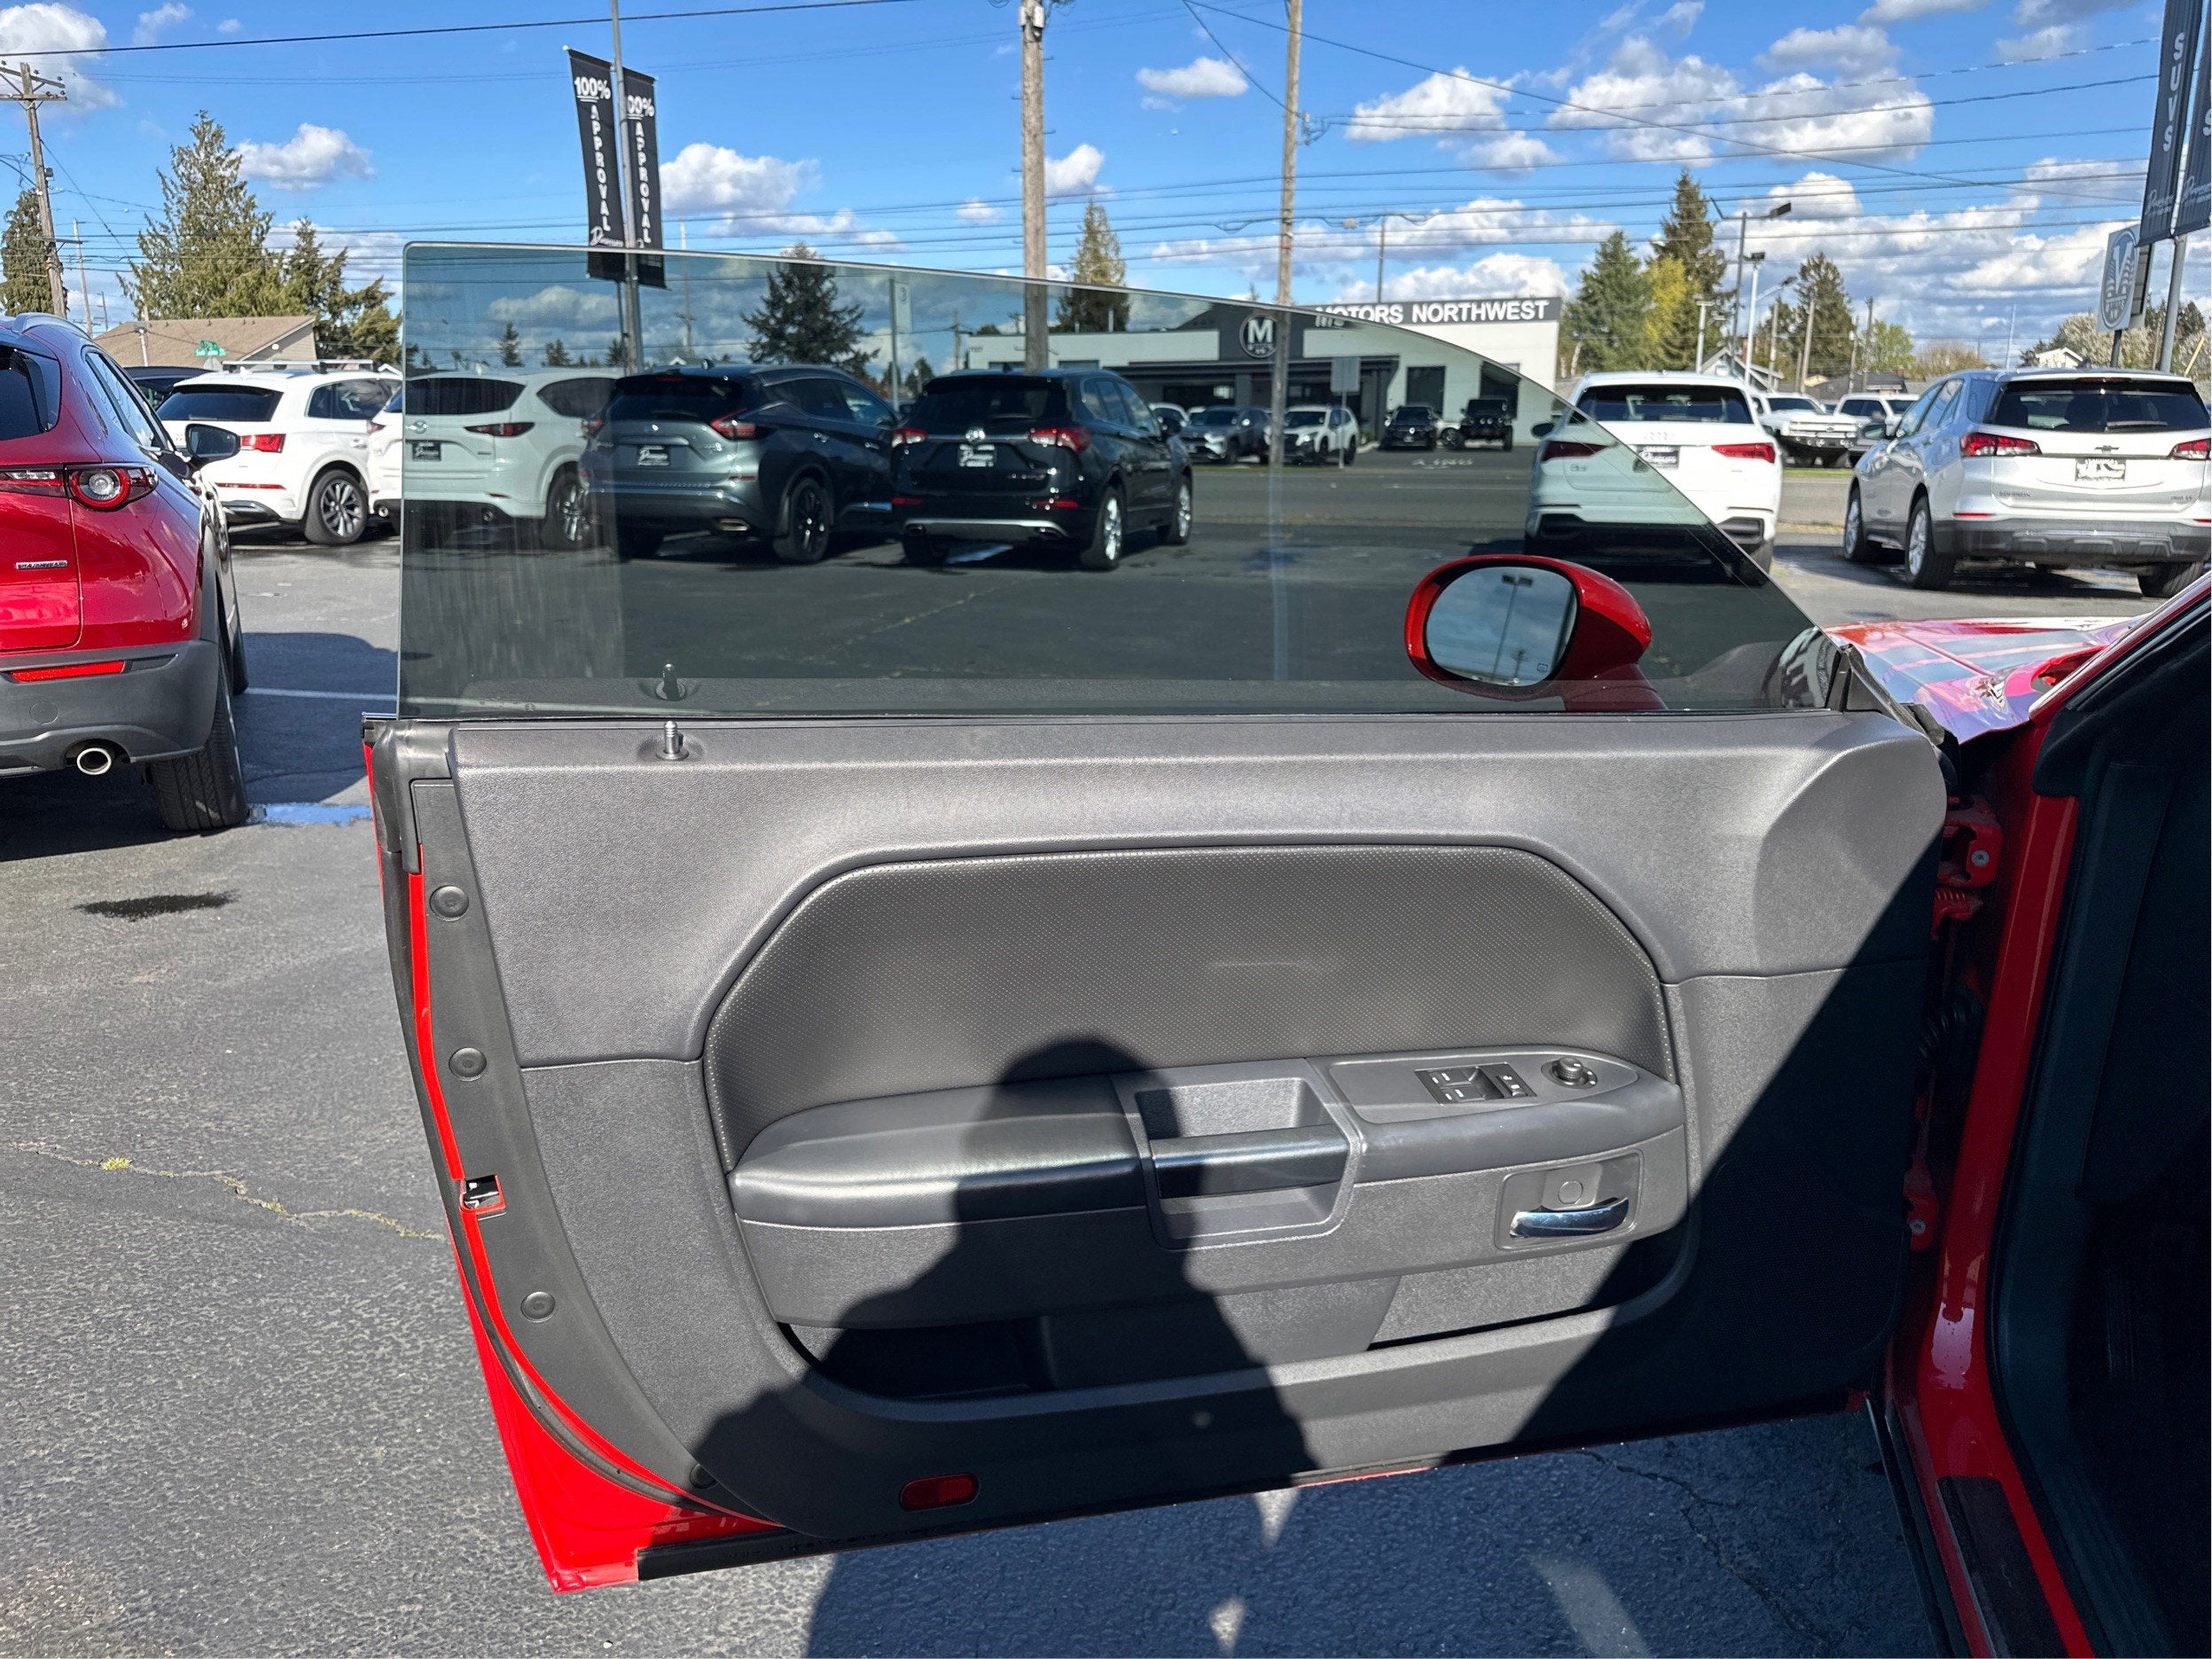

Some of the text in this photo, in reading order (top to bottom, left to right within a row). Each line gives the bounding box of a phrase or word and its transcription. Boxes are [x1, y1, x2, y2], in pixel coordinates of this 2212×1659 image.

[574, 76, 612, 100] 100%
[2162, 32, 2185, 153] SUVS
[626, 94, 655, 117] 00%
[590, 104, 612, 232] APPROVAL
[635, 121, 652, 244] APPROVAL
[1411, 300, 1551, 324] NORTHWEST
[1247, 318, 1274, 344] M
